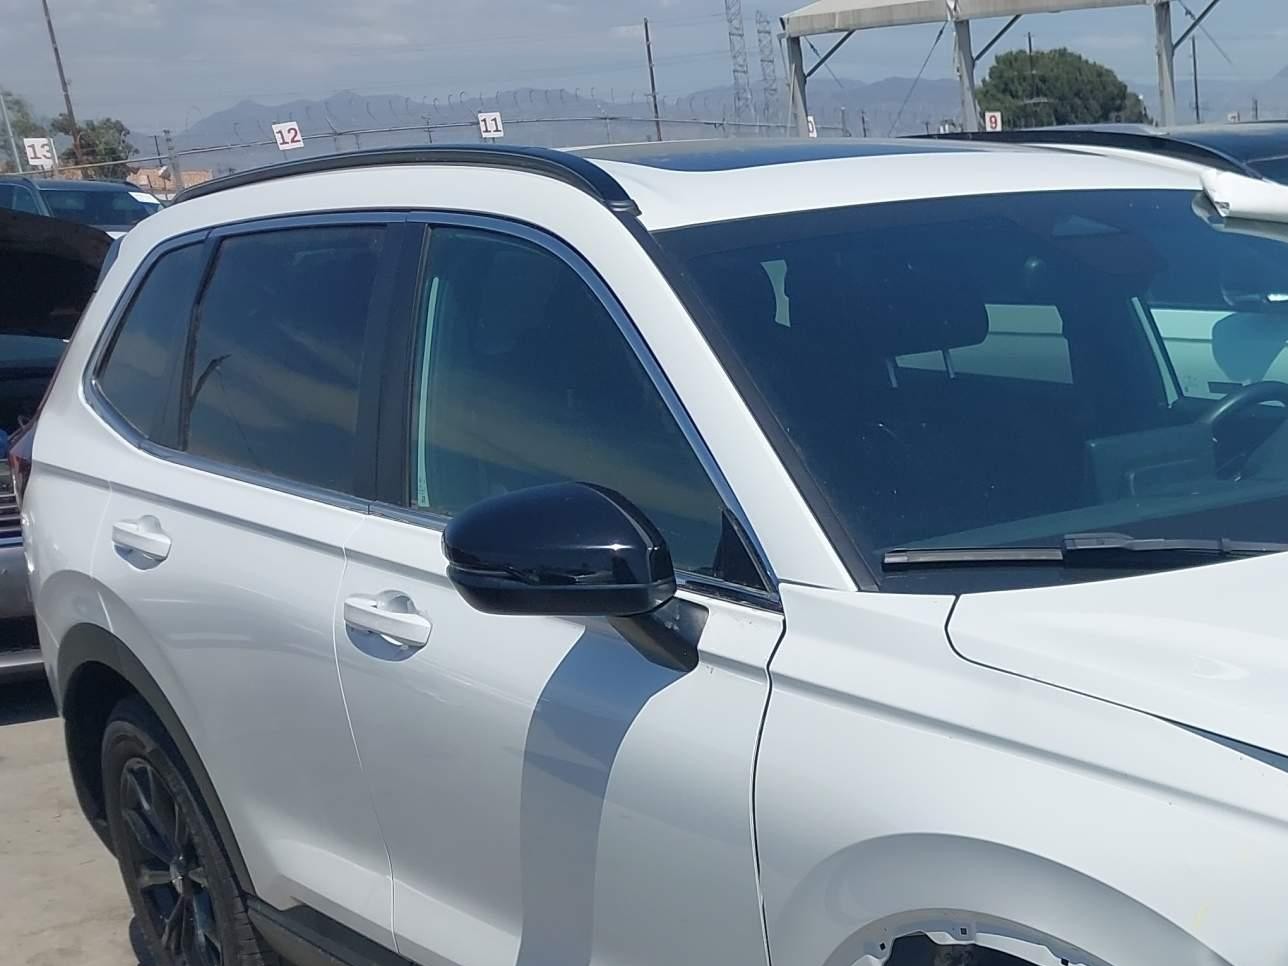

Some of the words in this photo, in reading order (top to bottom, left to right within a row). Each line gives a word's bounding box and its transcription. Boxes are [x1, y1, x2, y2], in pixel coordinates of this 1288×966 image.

[480, 117, 502, 133] 11
[989, 114, 998, 130] 9
[276, 127, 301, 145] 12
[27, 143, 52, 160] 13
